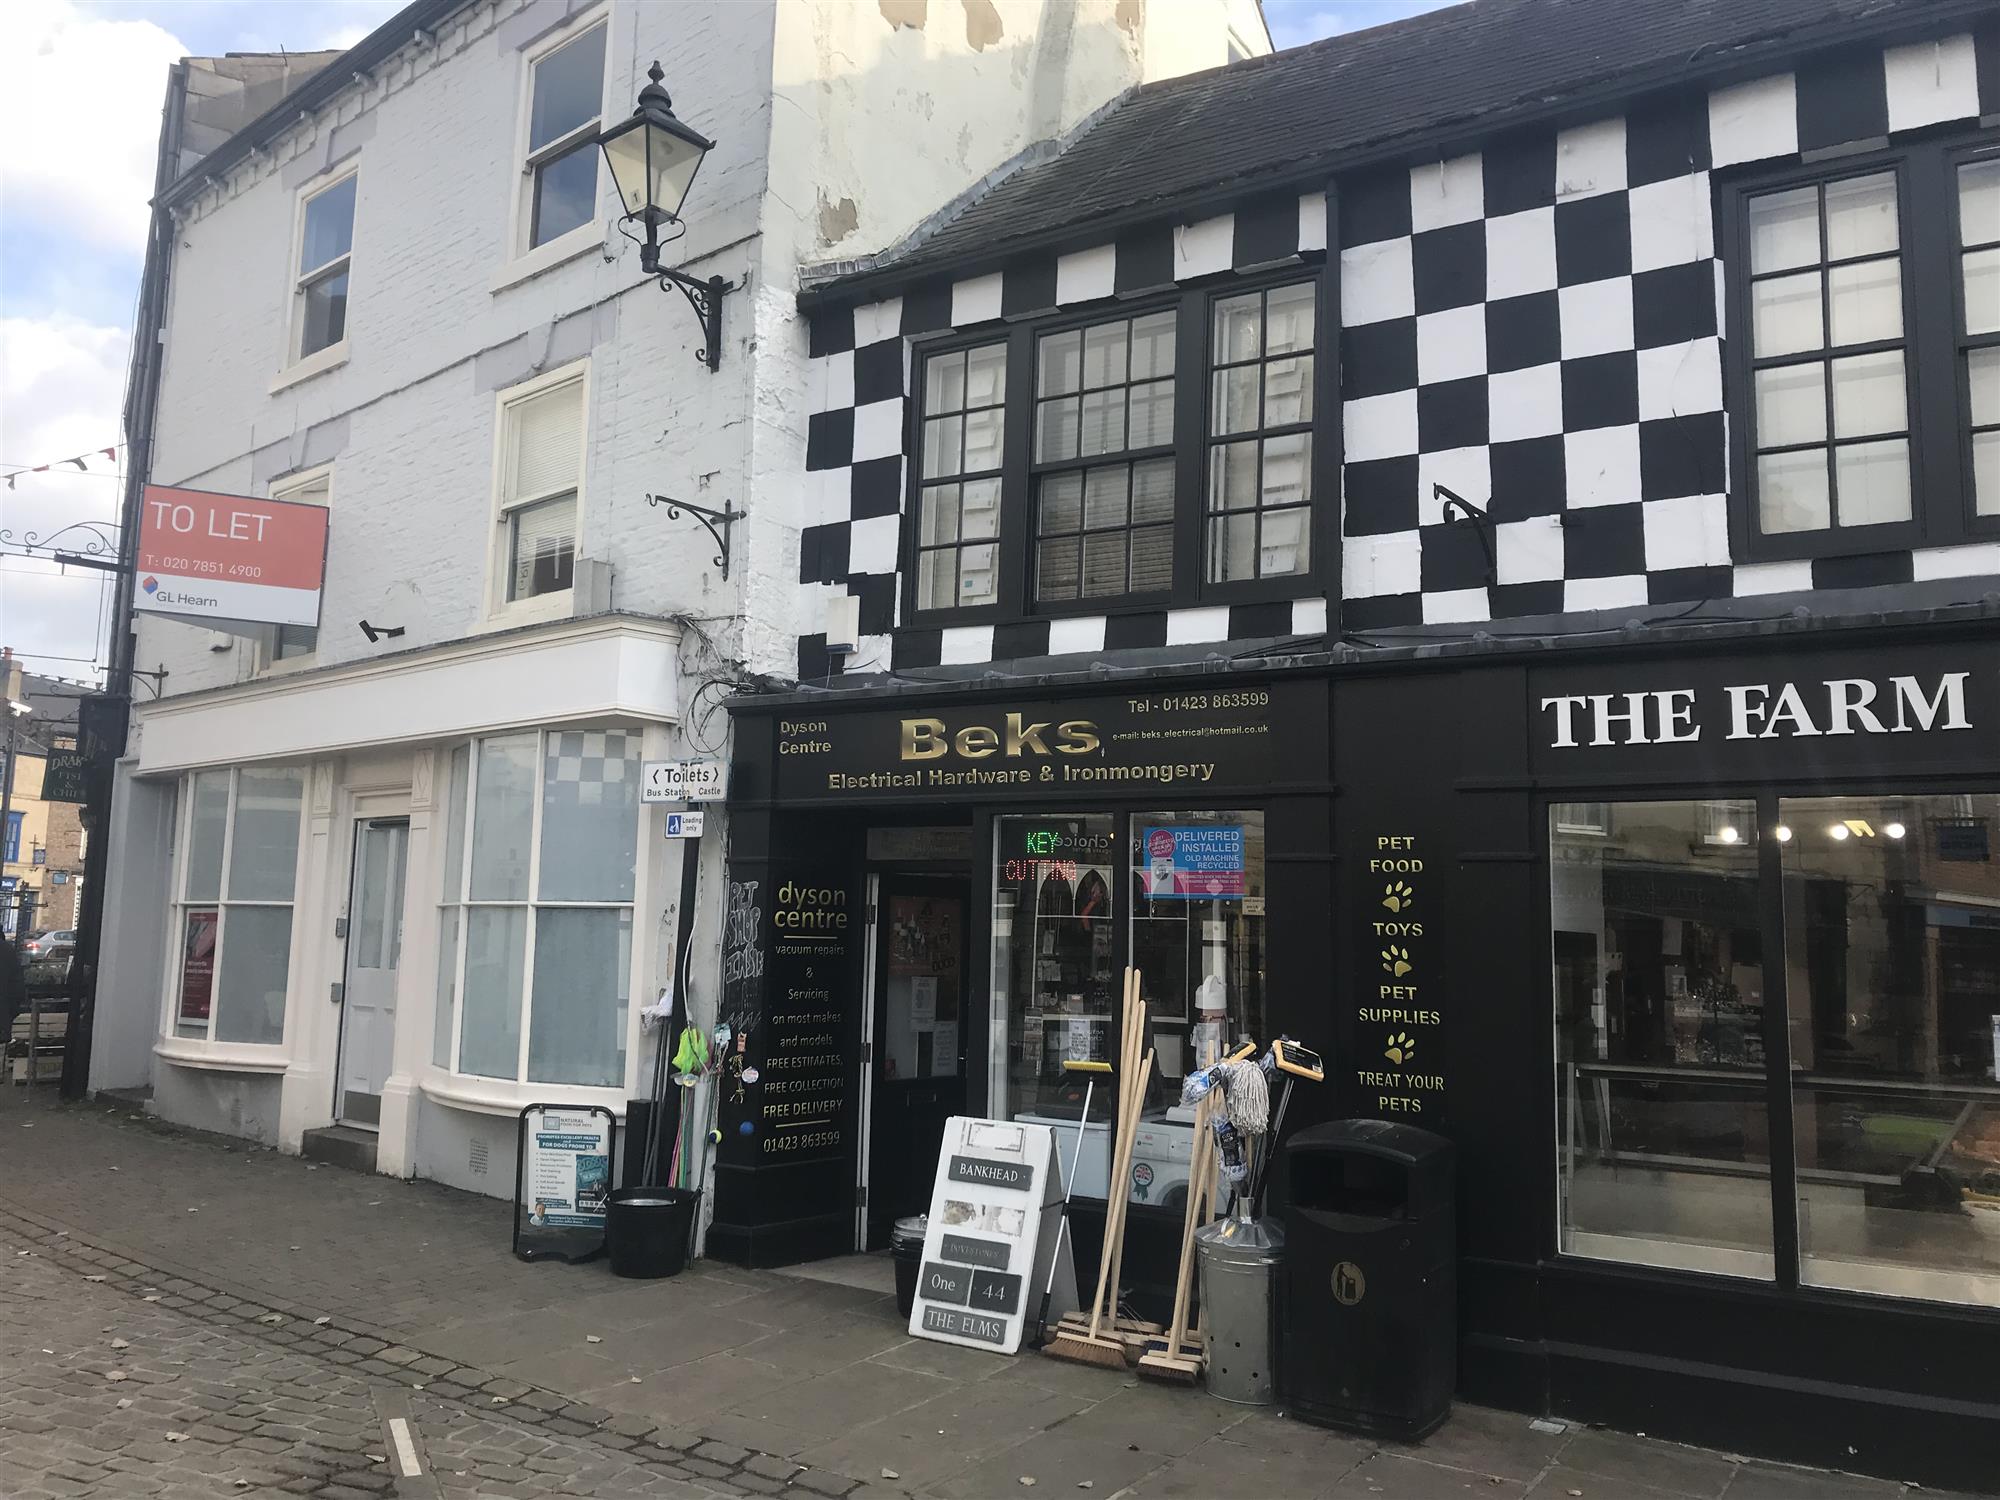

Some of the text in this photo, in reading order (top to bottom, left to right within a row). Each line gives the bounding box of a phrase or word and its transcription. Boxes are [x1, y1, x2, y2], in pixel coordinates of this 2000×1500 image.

[150, 501, 272, 542] TO LET
[145, 554, 261, 578] T: 020 7851 4900
[156, 591, 175, 603] GL
[177, 593, 218, 608] Hearn
[1128, 699, 1149, 713] Tel
[1163, 697, 1207, 711] 01423
[1213, 692, 1269, 709] 863599
[1541, 672, 1974, 748] THE FARM
[780, 721, 827, 736] Dyson
[900, 712, 1101, 760] Beks
[780, 740, 832, 755] Centre
[665, 768, 709, 783] Toilets
[828, 763, 1215, 789] Electrical Hardware & Ironmongery
[664, 788, 690, 796] Staton
[698, 787, 721, 795] Castle
[1027, 832, 1059, 853] KEY
[1175, 831, 1239, 842] DELIVERED
[1377, 836, 1415, 850] PET
[1182, 843, 1239, 853] INSTALLED
[1006, 860, 1076, 881] CUTTING
[1370, 859, 1424, 873] FOOD
[779, 881, 846, 910] dyson
[775, 909, 848, 928] centre
[1372, 922, 1423, 937] TOYS
[775, 945, 845, 956] vacuum repairs
[806, 967, 814, 978] &
[788, 988, 829, 1001] Servicing
[1380, 985, 1417, 1000] PET
[772, 1011, 841, 1025] on most makes
[1359, 1007, 1441, 1025] SUPPLIES
[780, 1034, 833, 1048] and models
[766, 1057, 790, 1070] FREE
[764, 1078, 844, 1094] FREE COLLECTION
[1357, 1071, 1444, 1091] TREAT YOUR
[763, 1099, 843, 1119] FREE DELIVERY
[1379, 1096, 1422, 1113] PETS
[763, 1131, 841, 1153] 01423 863599
[959, 1163, 1018, 1182] BANKHEAD
[931, 1273, 956, 1291] One
[982, 1283, 1006, 1300] 44
[927, 1311, 1000, 1339] THE ELMS
